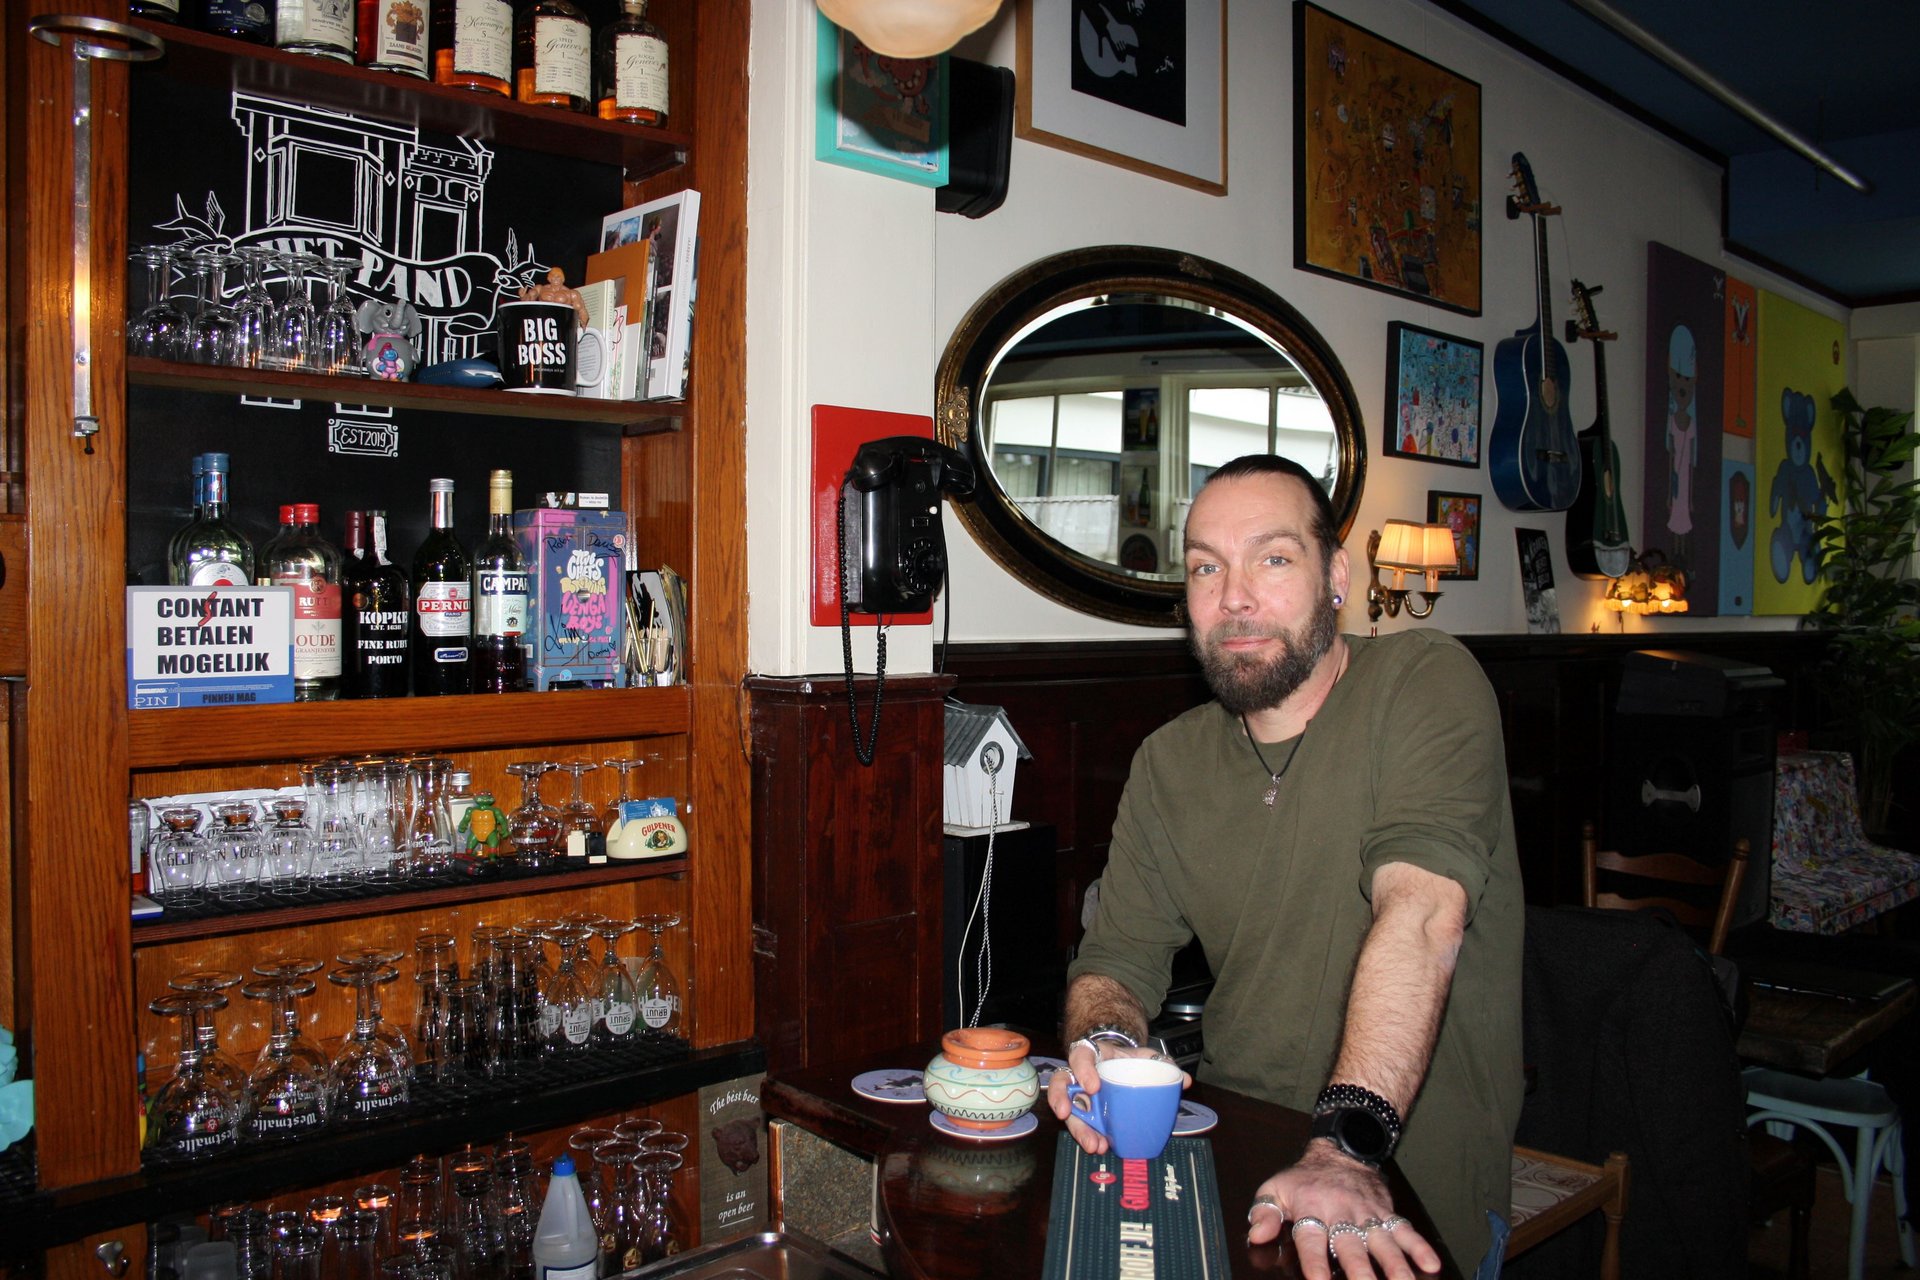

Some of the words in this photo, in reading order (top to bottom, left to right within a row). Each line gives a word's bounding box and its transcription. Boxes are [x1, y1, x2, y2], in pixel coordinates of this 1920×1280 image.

[353, 247, 472, 308] PAND
[523, 317, 558, 342] BIG
[518, 342, 566, 366] BOSS
[157, 598, 264, 618] CONTANT
[299, 597, 332, 607] RUTT
[421, 600, 471, 611] PERNO
[359, 611, 408, 624] KOPKE
[157, 625, 253, 646] BETALEN
[296, 634, 336, 647] OUDE
[357, 639, 384, 649] FINE
[157, 653, 269, 675] MOGELIJK
[367, 655, 403, 664] PORTO
[134, 696, 168, 707] PIN
[202, 693, 235, 704] PINNEN
[236, 692, 256, 702] MAG
[641, 822, 676, 837] GULPENER
[645, 1008, 668, 1017] BRUUT
[709, 1097, 725, 1115] The
[726, 1090, 742, 1105] best
[742, 1089, 759, 1105] beer
[253, 1111, 317, 1131] Westmalle
[726, 1192, 734, 1202] is
[735, 1189, 746, 1199] an
[718, 1208, 737, 1223] open
[737, 1202, 755, 1215] beer
[1119, 1243, 1155, 1280] ROEF
